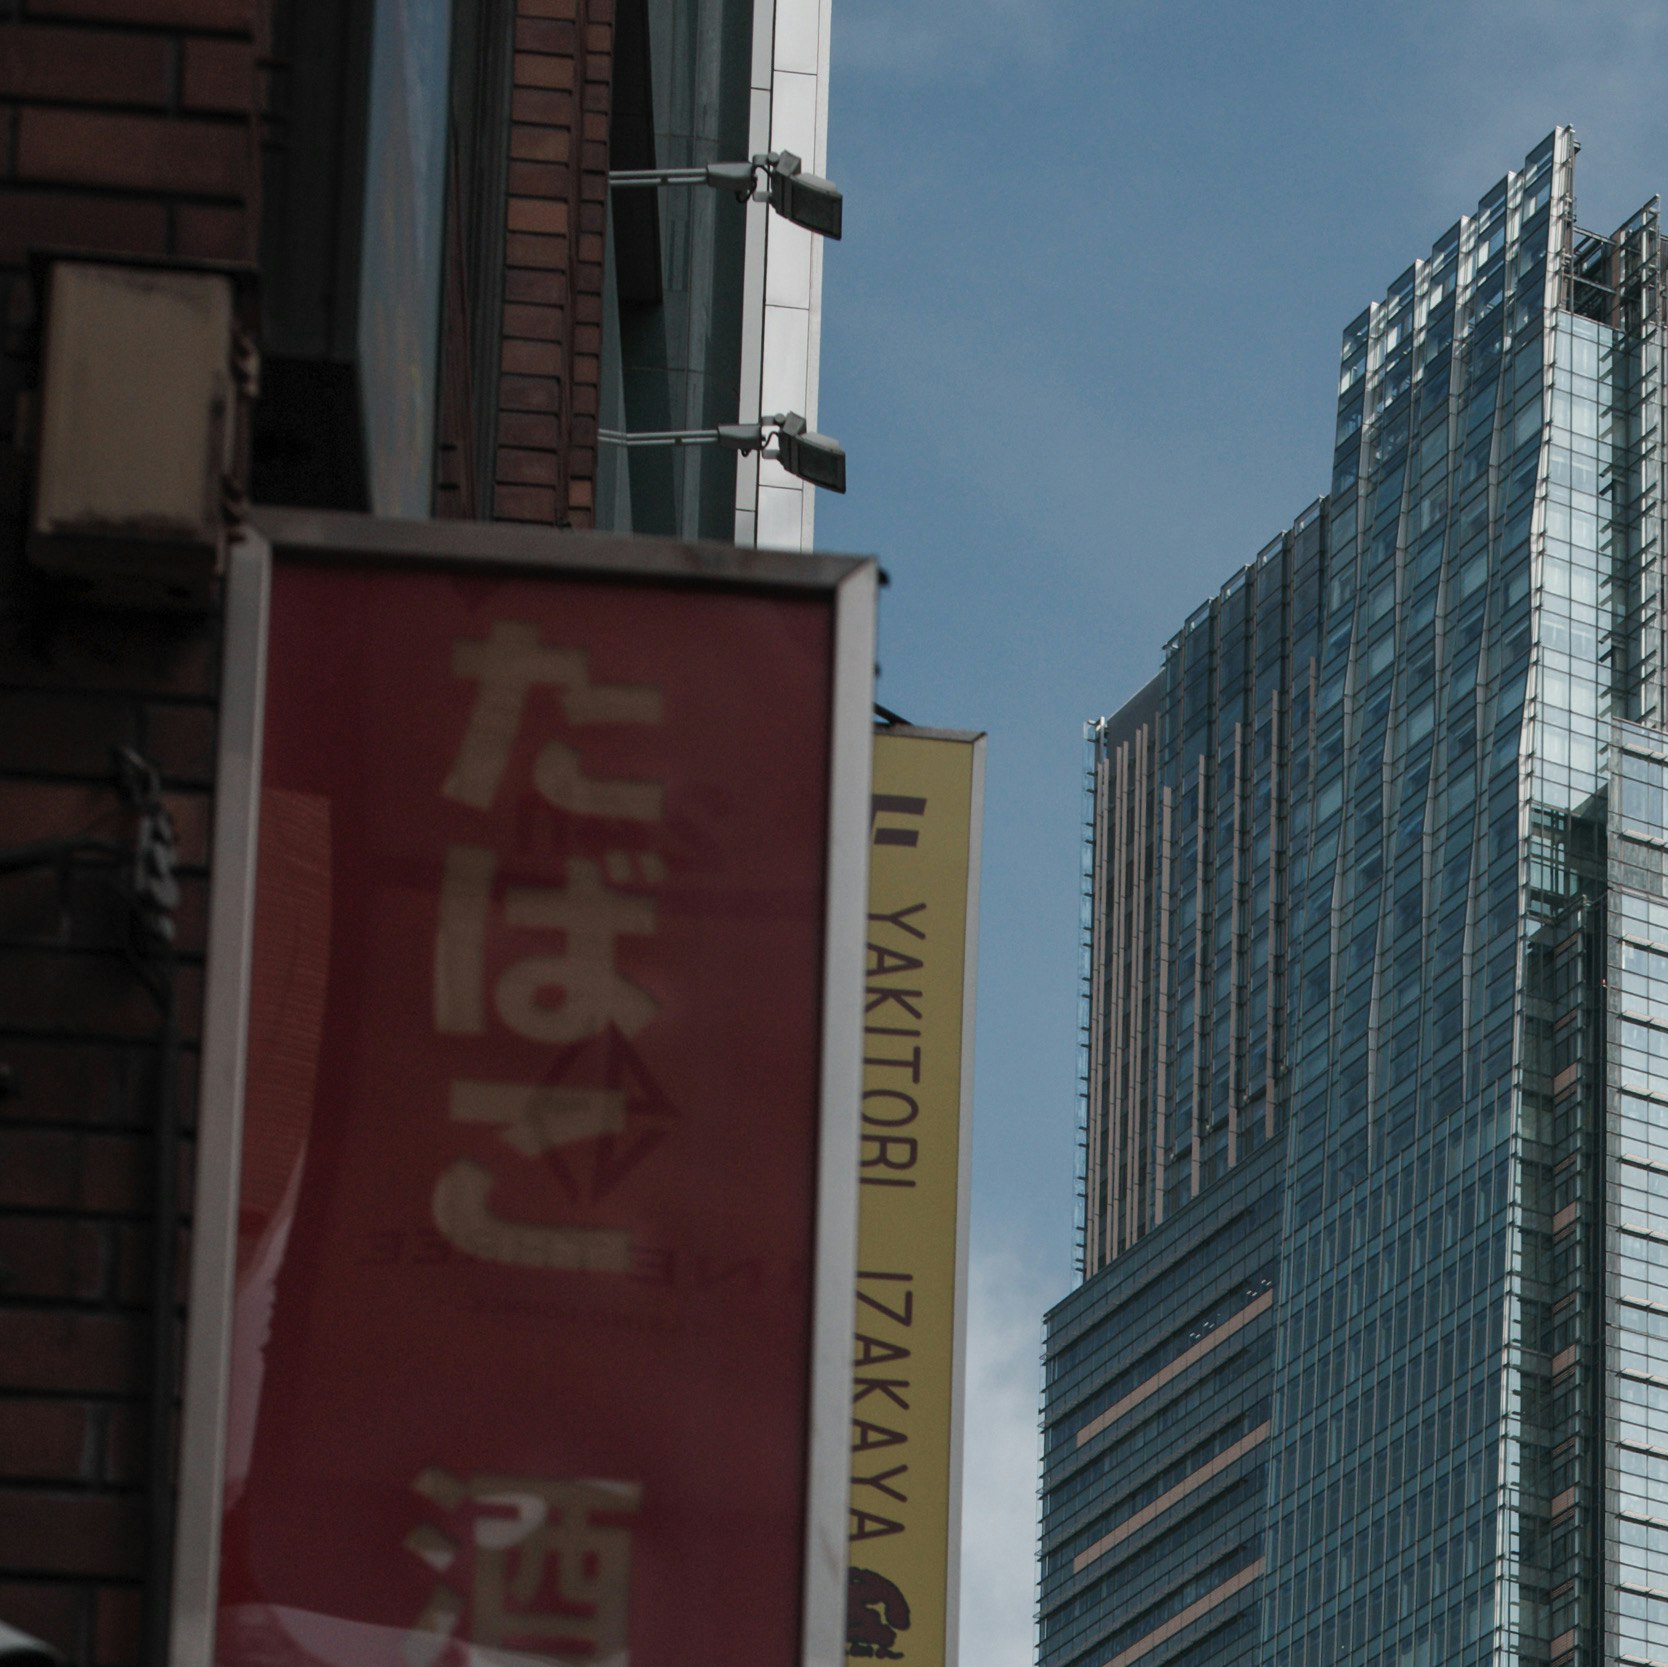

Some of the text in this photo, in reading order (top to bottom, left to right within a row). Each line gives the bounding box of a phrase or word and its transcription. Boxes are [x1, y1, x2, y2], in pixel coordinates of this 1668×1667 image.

[432, 616, 669, 1278] たばこ
[858, 902, 927, 1188] YAKITORI
[849, 1273, 914, 1543] IZAKAYA
